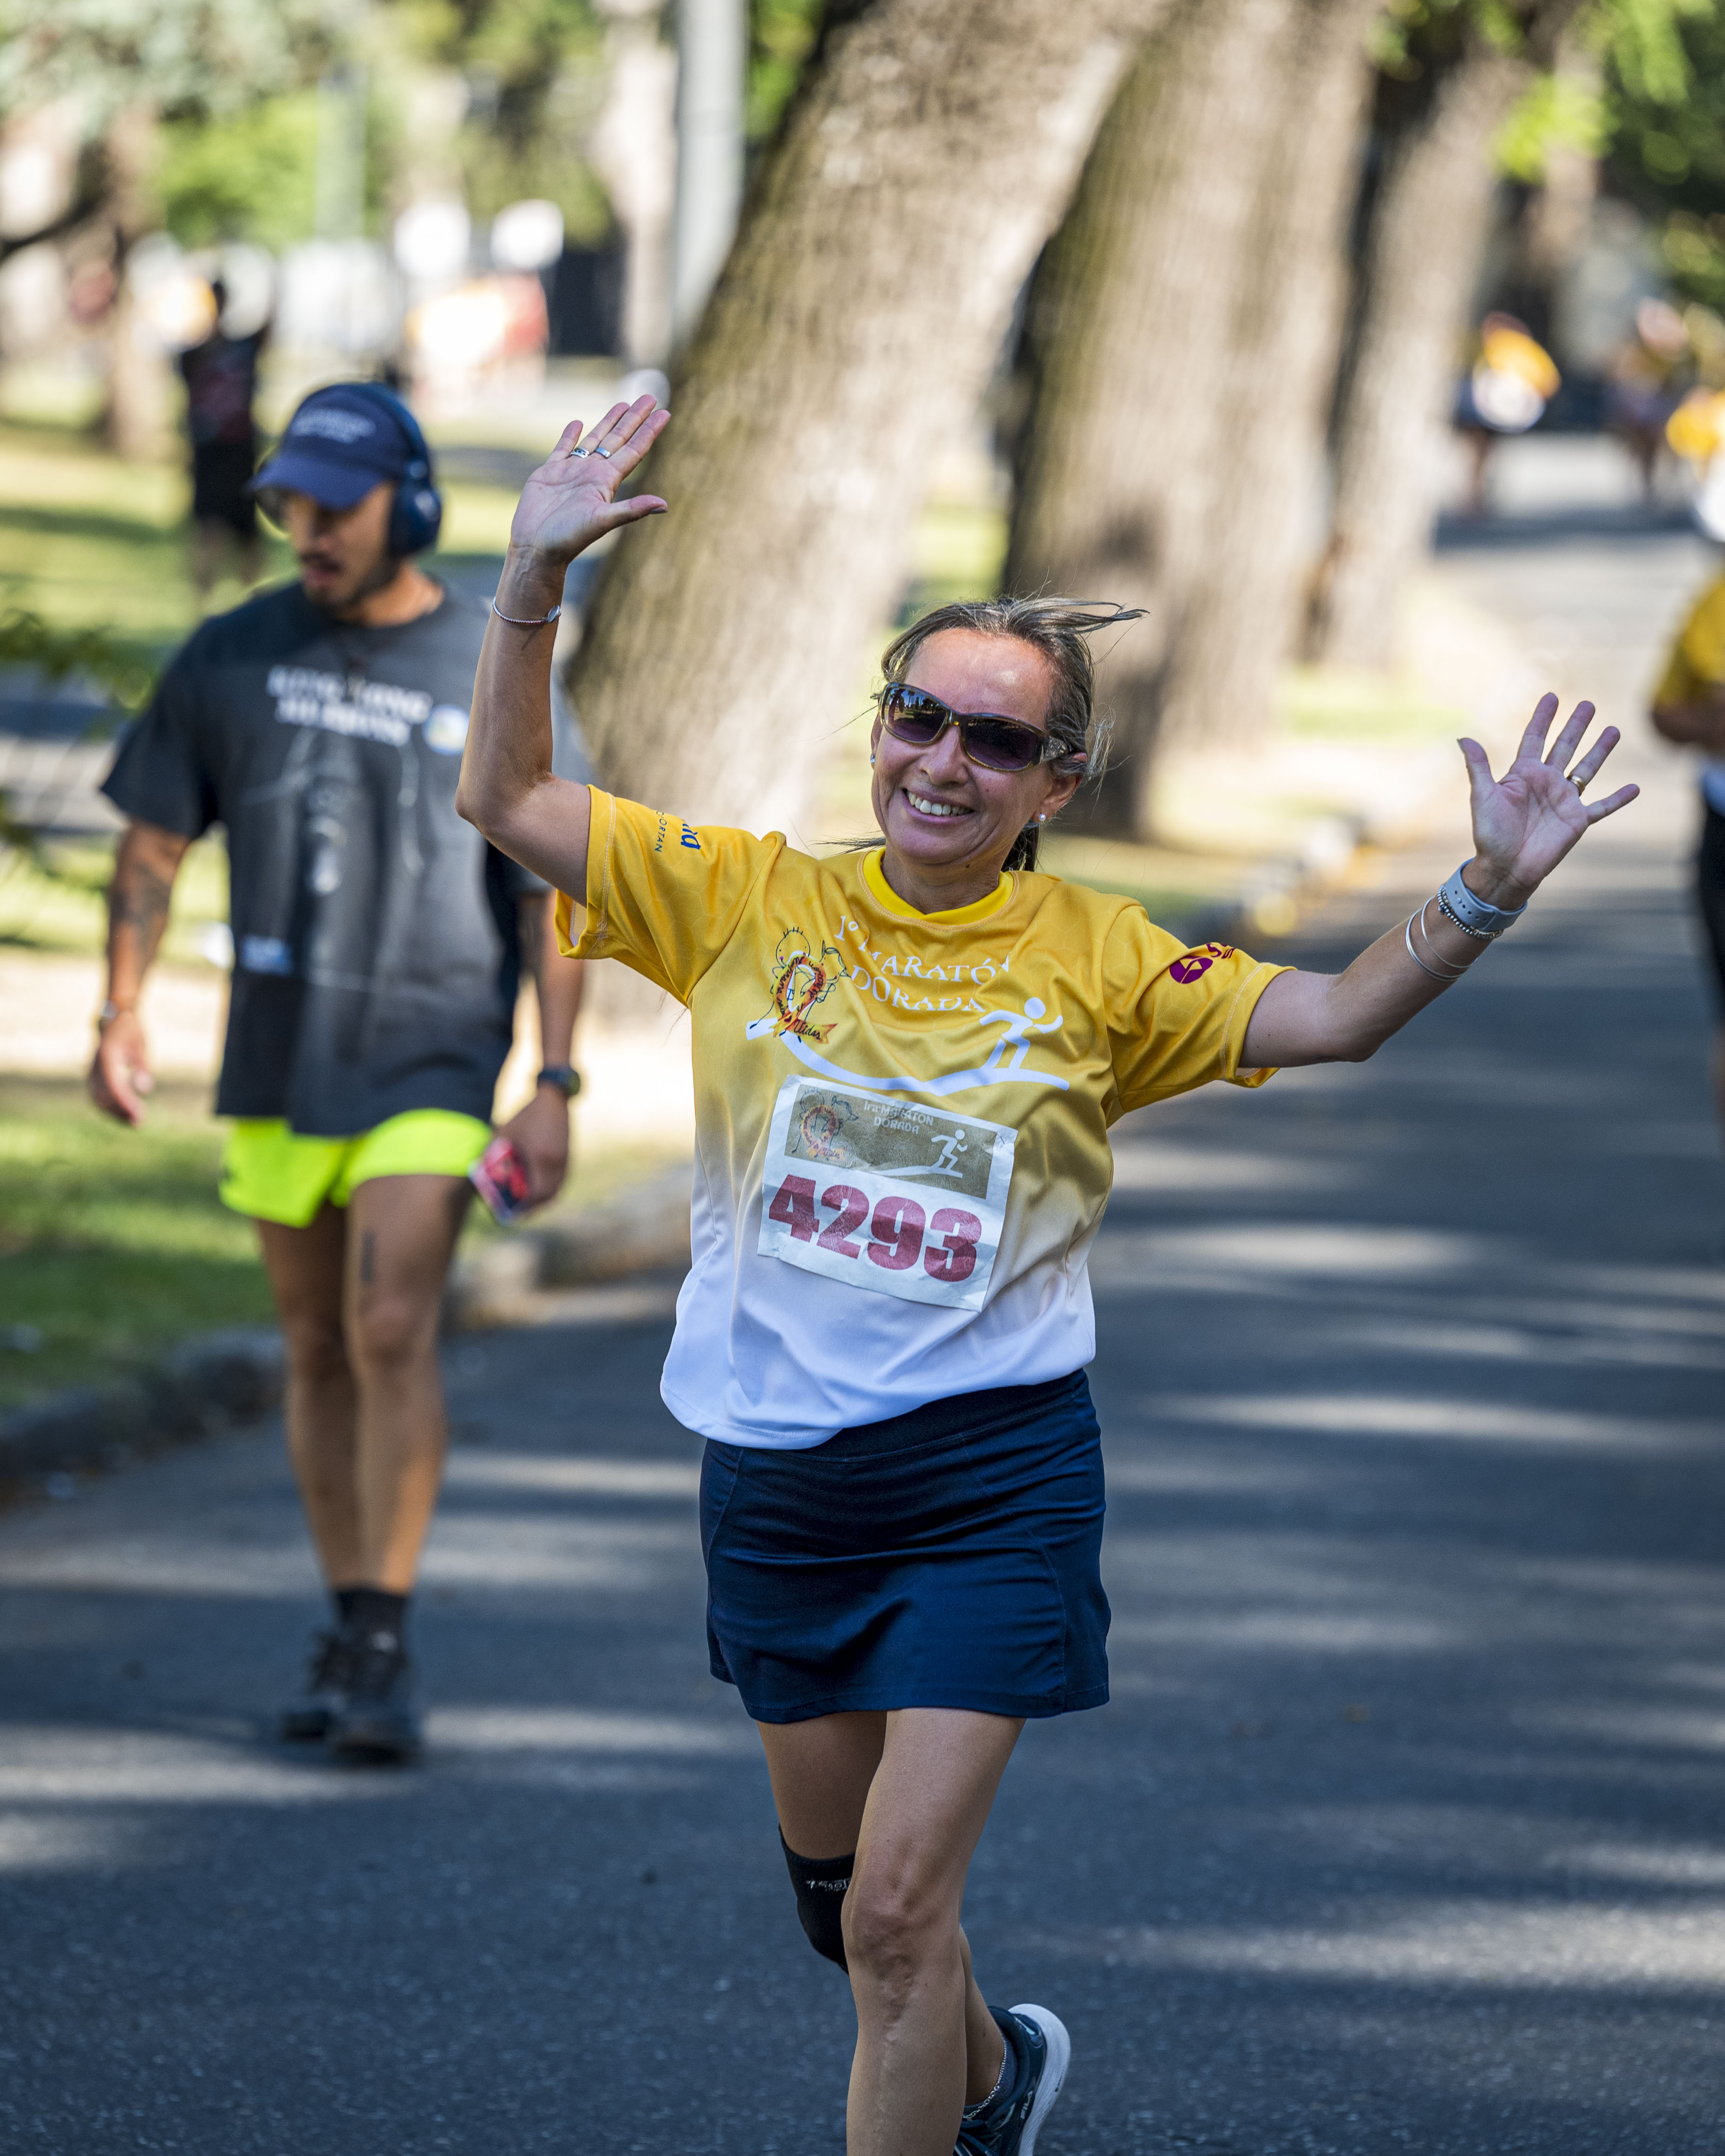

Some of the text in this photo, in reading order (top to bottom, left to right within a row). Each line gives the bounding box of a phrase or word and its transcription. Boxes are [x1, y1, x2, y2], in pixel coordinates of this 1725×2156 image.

[850, 965, 986, 1012] DORADA
[874, 1116, 920, 1134] DORADA
[769, 1174, 982, 1283] 4293
